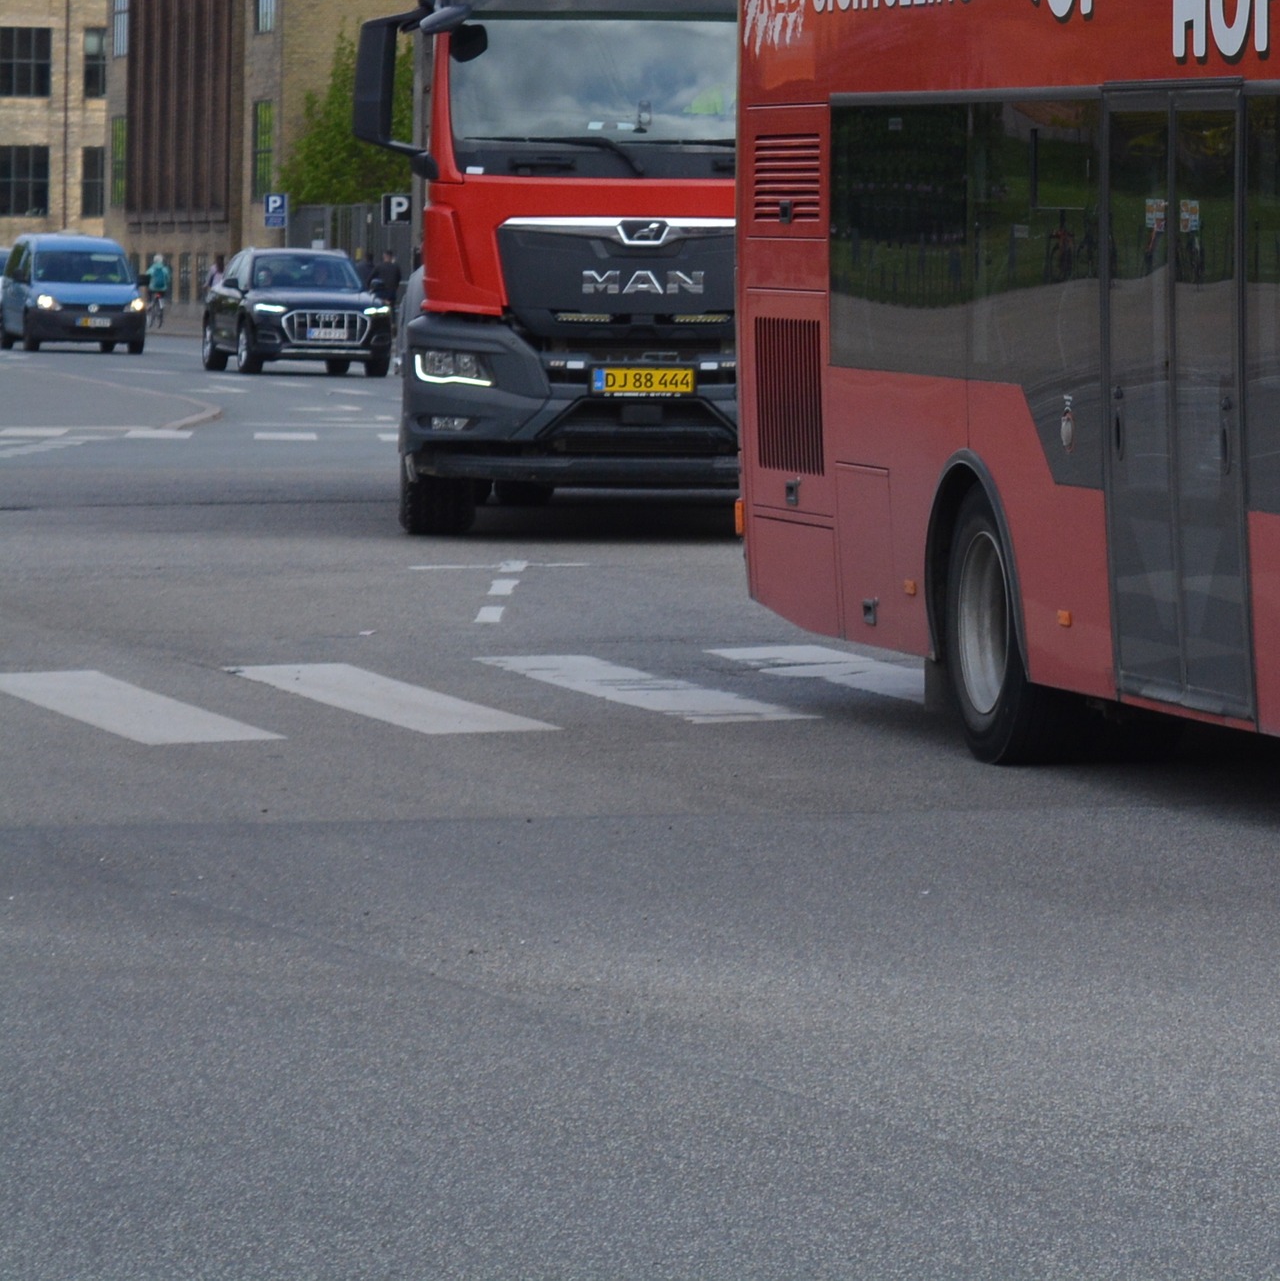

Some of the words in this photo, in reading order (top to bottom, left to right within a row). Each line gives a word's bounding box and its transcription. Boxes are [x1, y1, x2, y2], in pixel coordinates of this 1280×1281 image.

[269, 195, 282, 213] P
[390, 196, 409, 221] P
[582, 270, 705, 294] MAN
[605, 373, 628, 388] DJ
[633, 373, 653, 388] 88
[658, 373, 690, 388] 444
